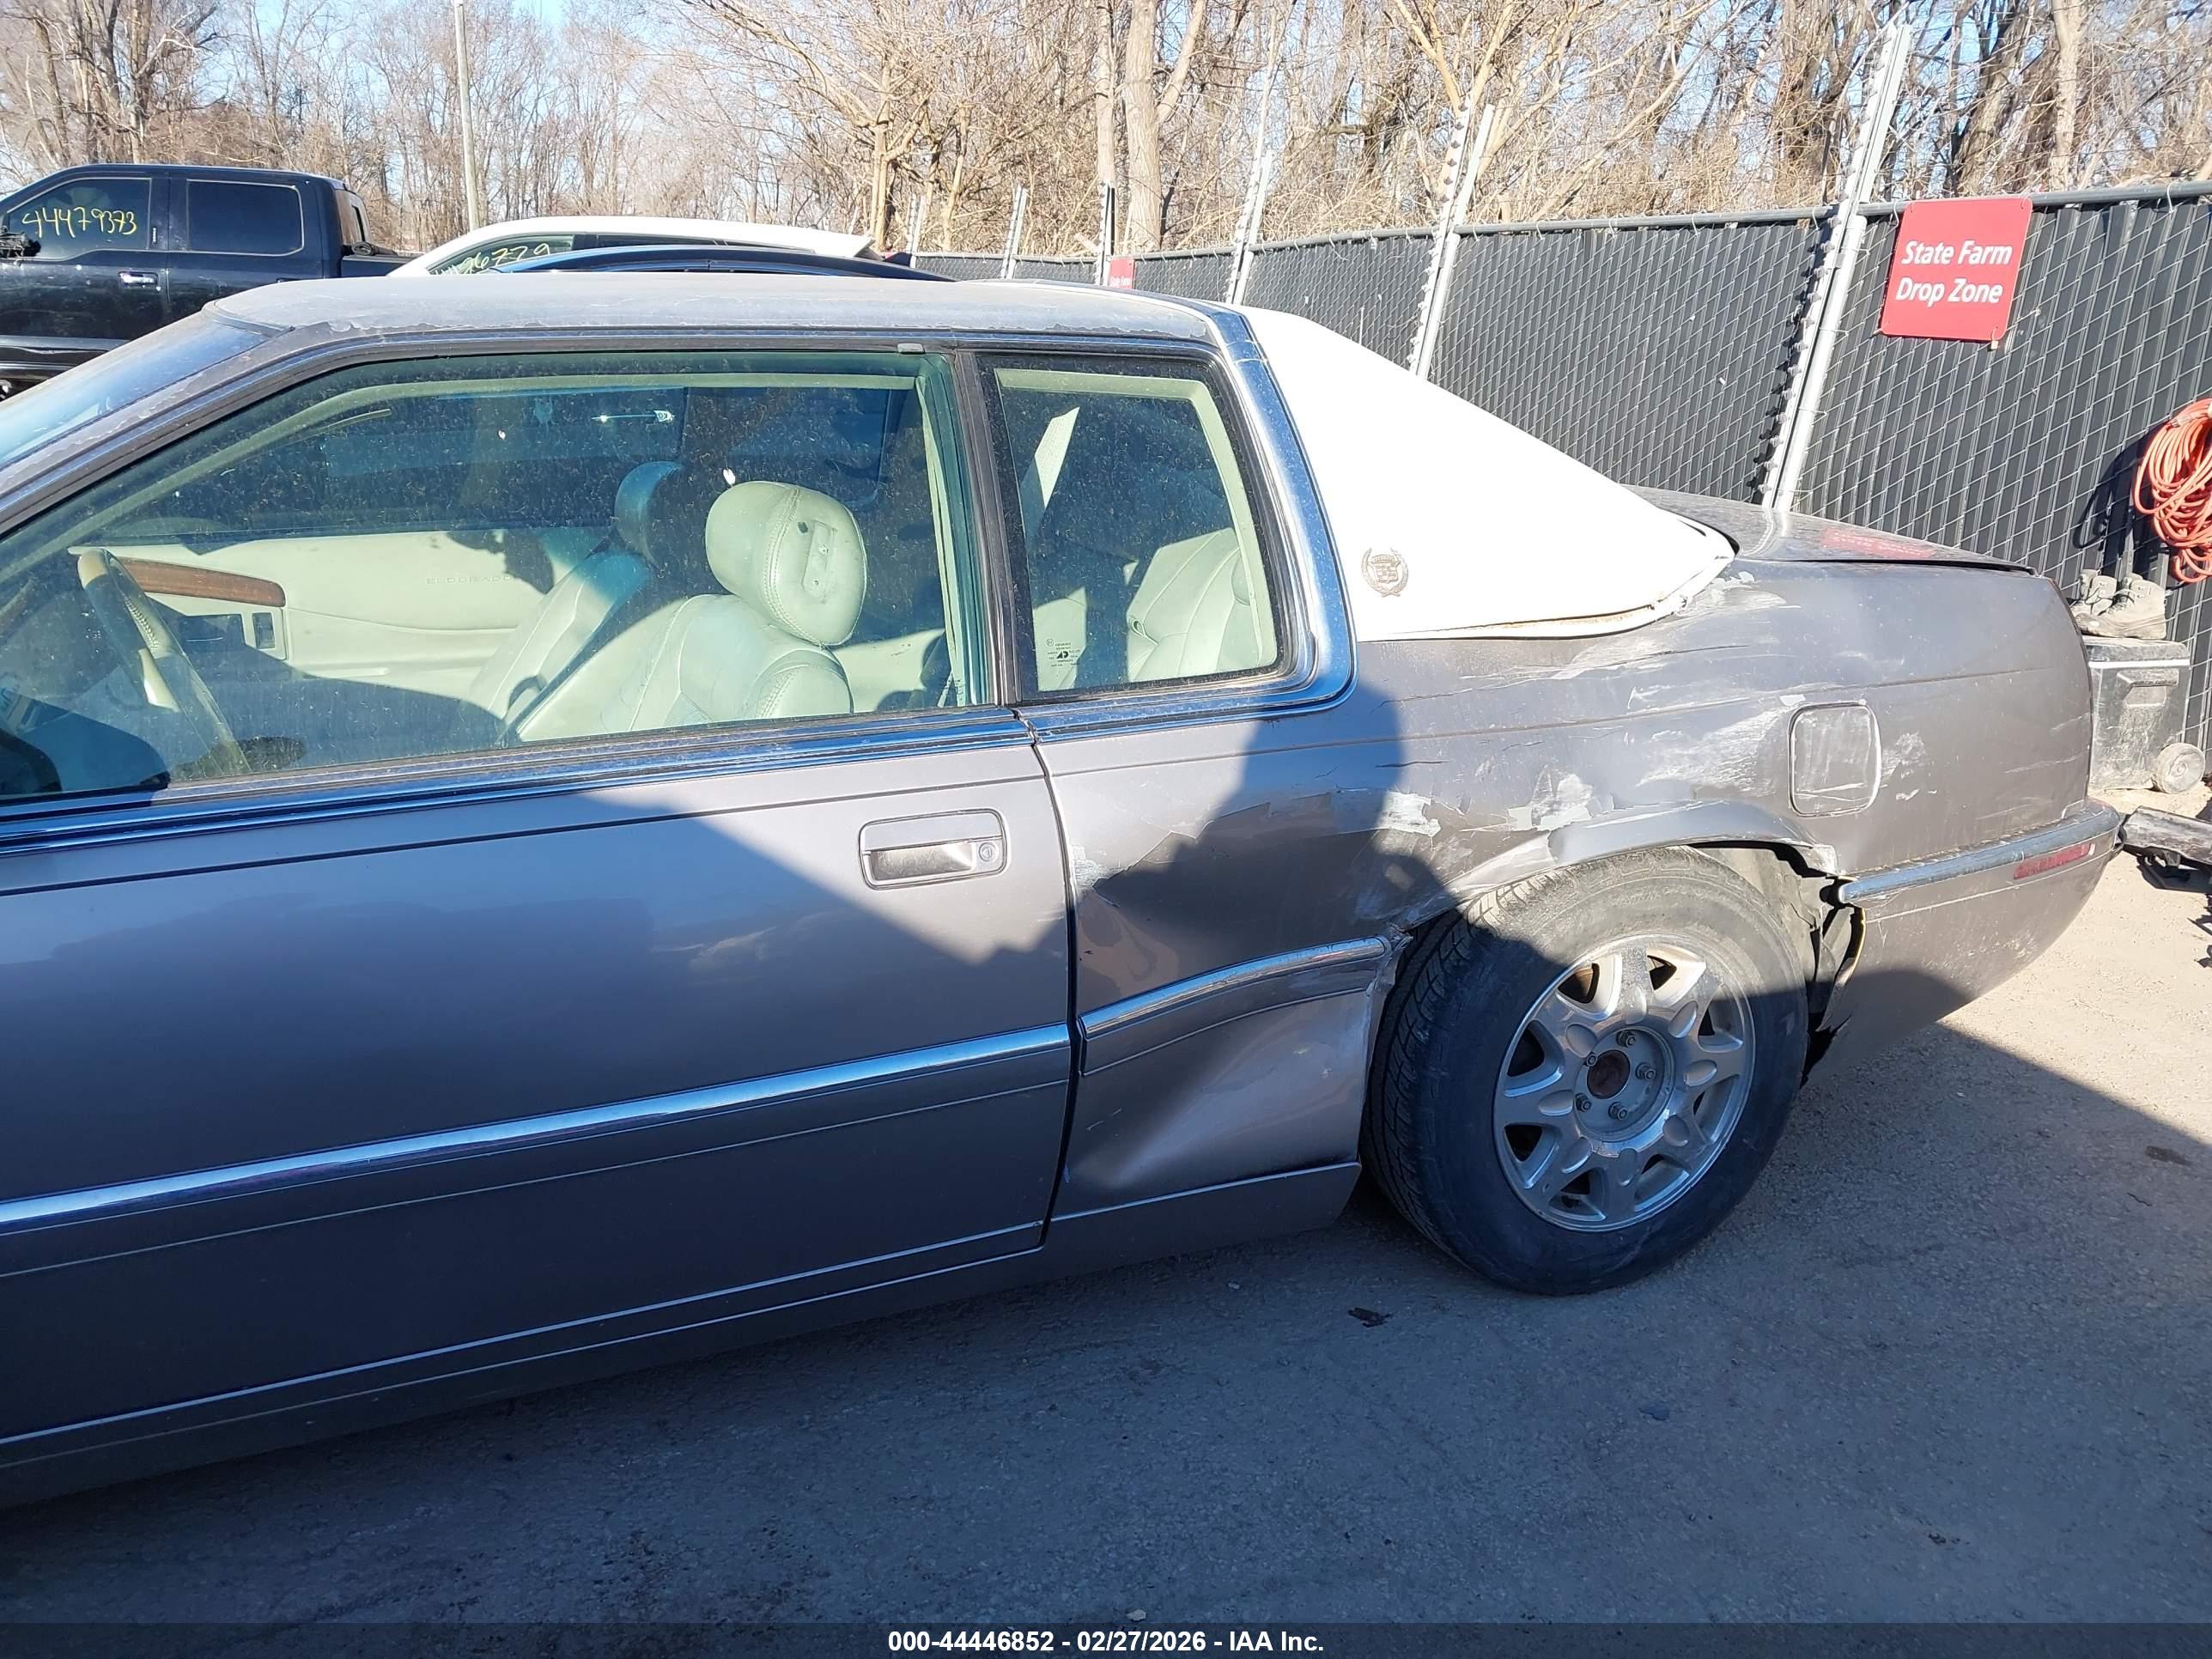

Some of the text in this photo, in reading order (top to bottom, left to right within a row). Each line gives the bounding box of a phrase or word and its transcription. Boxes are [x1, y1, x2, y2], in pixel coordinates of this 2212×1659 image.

[22, 206, 137, 239] 44479373
[1901, 240, 2013, 265] State Farm
[1895, 276, 2003, 308] Drop Zone
